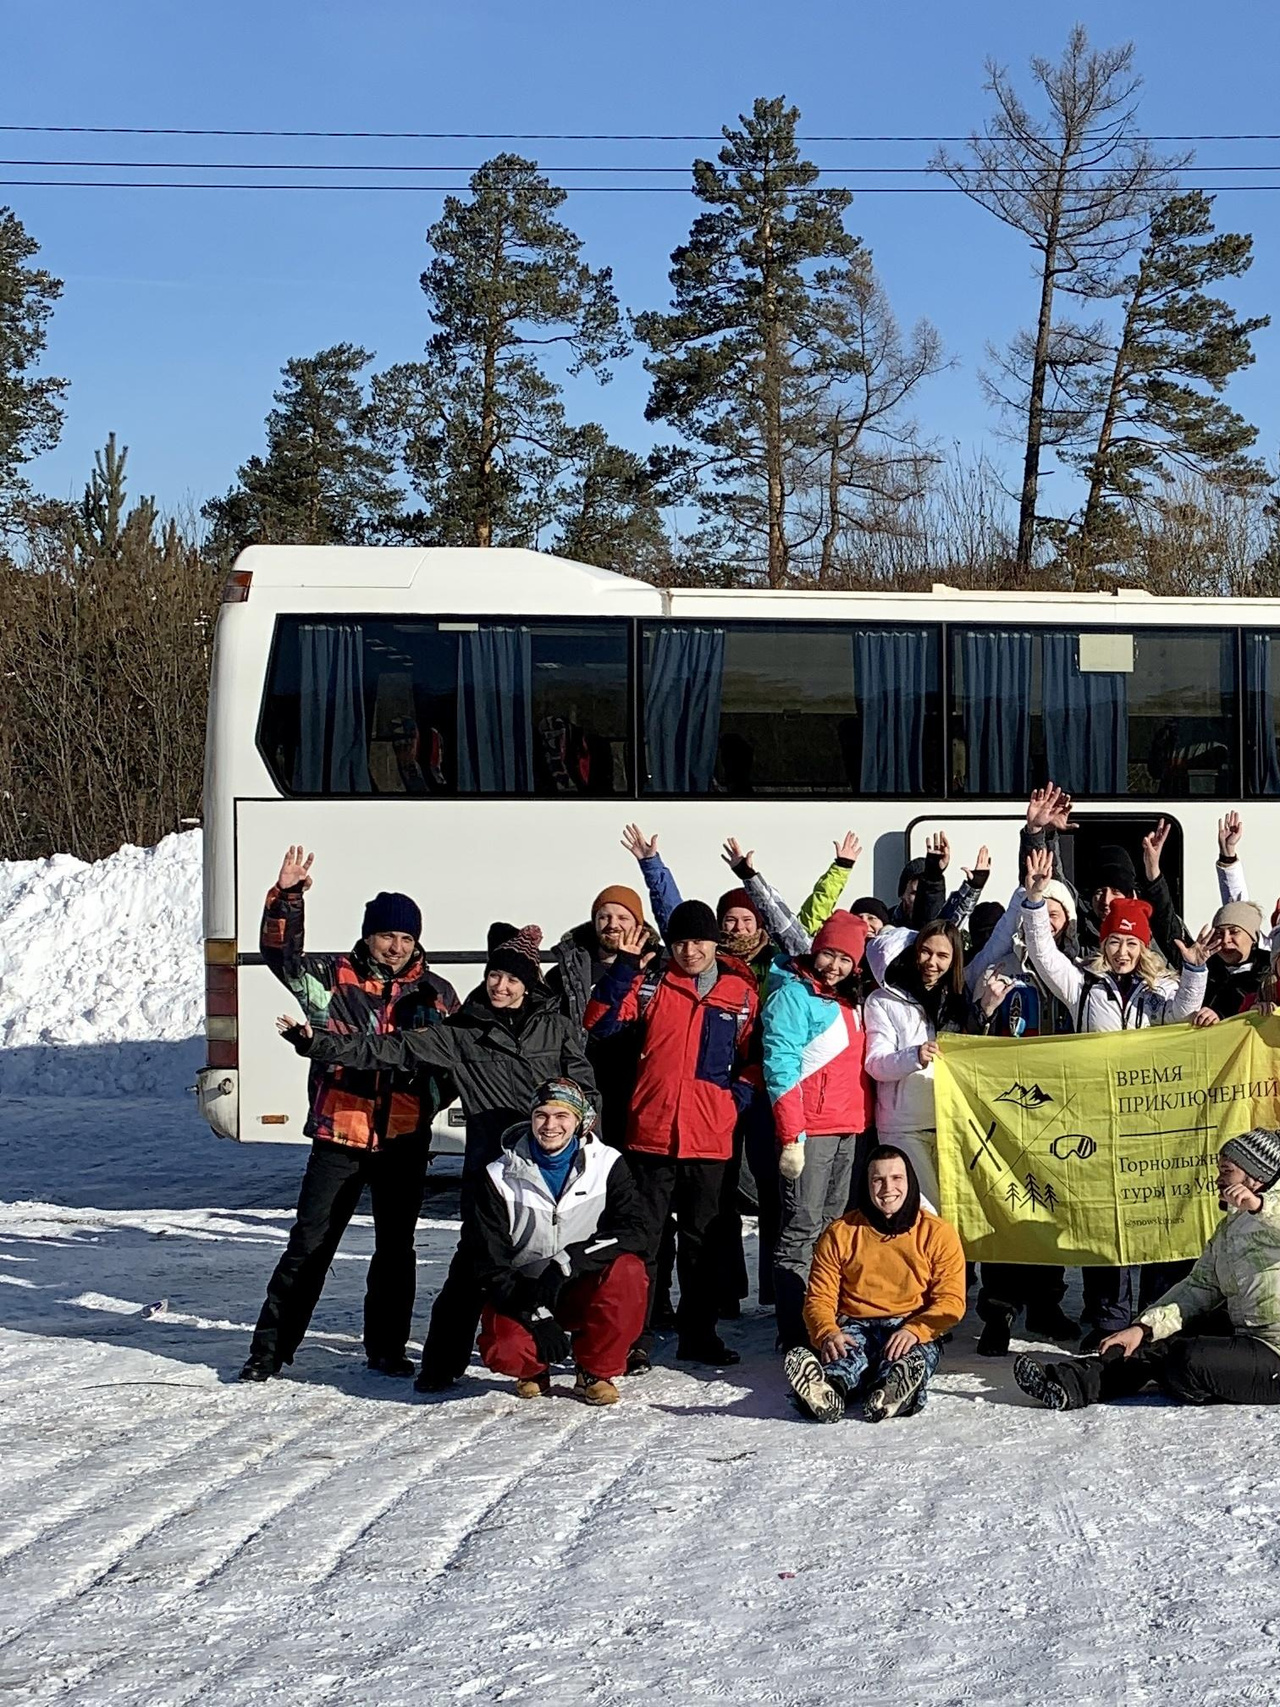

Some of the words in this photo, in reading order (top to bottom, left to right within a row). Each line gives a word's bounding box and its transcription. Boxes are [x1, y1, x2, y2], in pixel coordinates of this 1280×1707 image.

[1116, 1065, 1183, 1087] ВРЕМЯ
[1118, 1077, 1279, 1114] ПРИКЛЮЧЕНИЙ
[1118, 1153, 1219, 1177] Горнолыжн
[1121, 1185, 1166, 1204] туры
[1171, 1183, 1191, 1196] из
[1194, 1175, 1218, 1197] Уф
